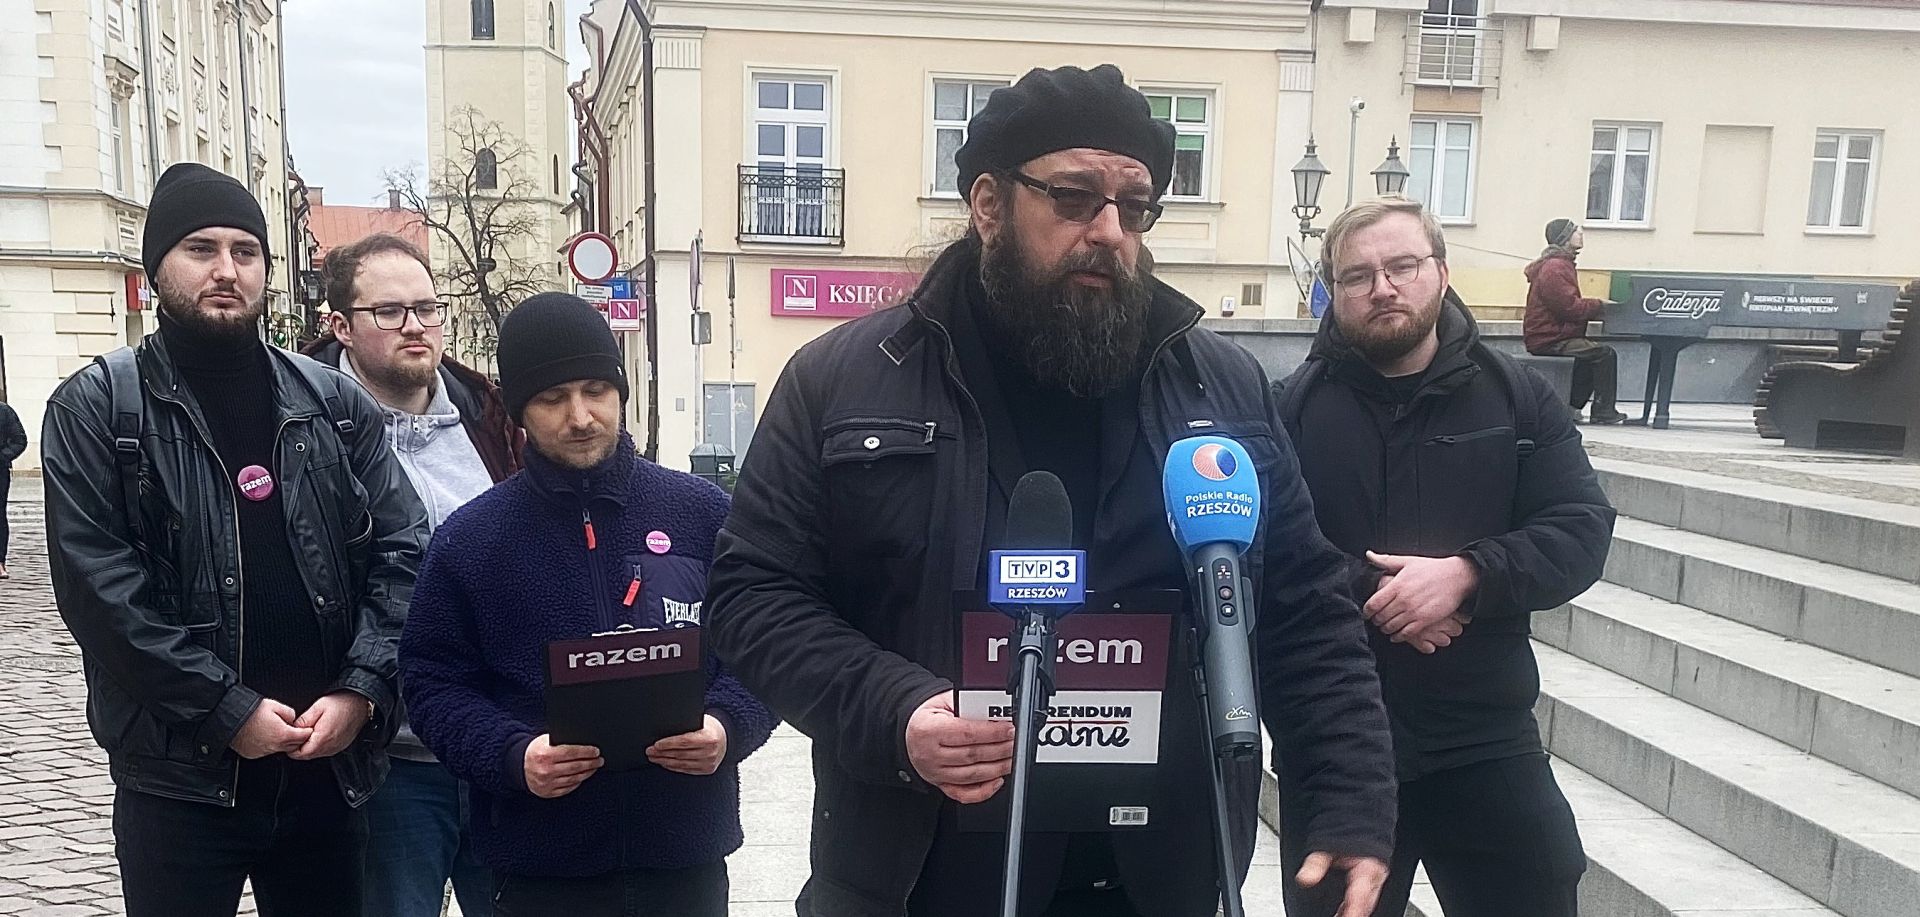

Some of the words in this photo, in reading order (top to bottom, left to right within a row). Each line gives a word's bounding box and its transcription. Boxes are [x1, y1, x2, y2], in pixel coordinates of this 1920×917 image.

[792, 278, 808, 296] N
[617, 302, 631, 318] N
[1643, 288, 1721, 319] Cadenza
[240, 475, 272, 492] razem
[1186, 491, 1224, 504] Polskie
[1226, 492, 1253, 504] Radio
[1187, 501, 1252, 518] RZESZÓW
[1008, 586, 1067, 598] RZESZÓW
[568, 643, 681, 668] razem
[988, 706, 1132, 718] RERENDUM
[1038, 719, 1130, 748] olne
